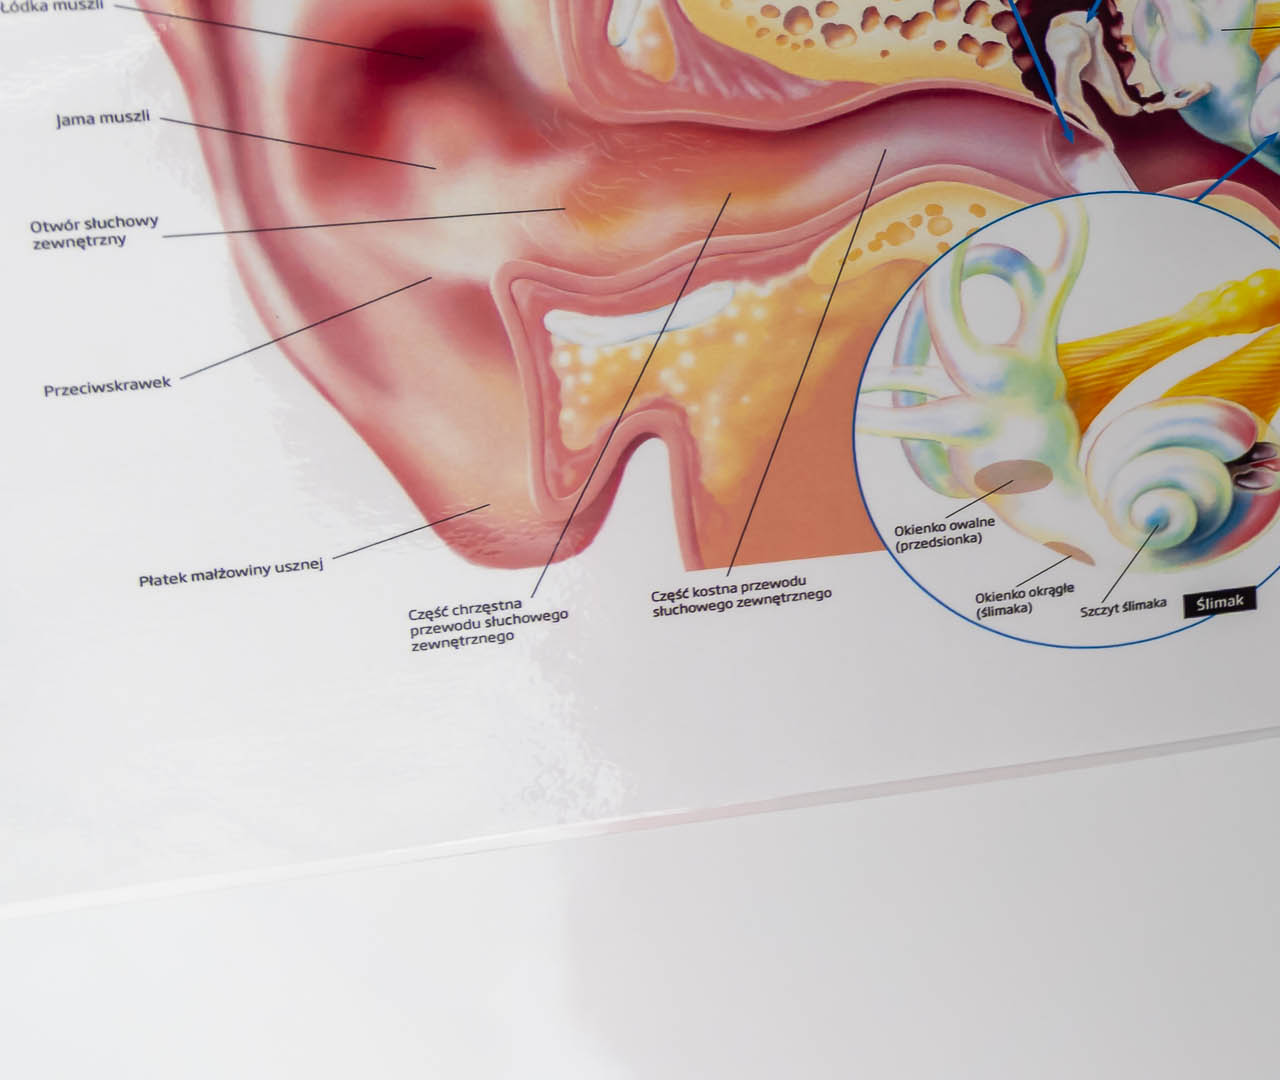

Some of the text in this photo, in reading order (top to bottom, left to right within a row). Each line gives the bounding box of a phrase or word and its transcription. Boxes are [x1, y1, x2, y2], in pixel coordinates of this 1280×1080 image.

[0, 0, 48, 13] Łódka
[56, 109, 150, 130] Jama muszli
[30, 215, 159, 233] Otwór słuchowy
[33, 234, 126, 250] zewnętrzny
[44, 376, 172, 397] Przeciwskrawek
[894, 516, 995, 537] Okienko owalne
[895, 532, 983, 554] (przedsionka)
[139, 557, 324, 587] Płatek małżowiny usznej
[651, 575, 807, 603] Część kostna przewodu
[975, 581, 1075, 604] Okienko okrągłe
[408, 597, 522, 621] Część chrzęstna
[653, 587, 832, 618] słuchowego zewnętrznego
[976, 602, 1033, 621] (ślimaka)
[1080, 596, 1167, 618] Szczyt ślimaka
[1196, 593, 1244, 611] Ślimak
[410, 609, 569, 638] przewodu słuchowego
[411, 630, 514, 652] zewnętrznego
